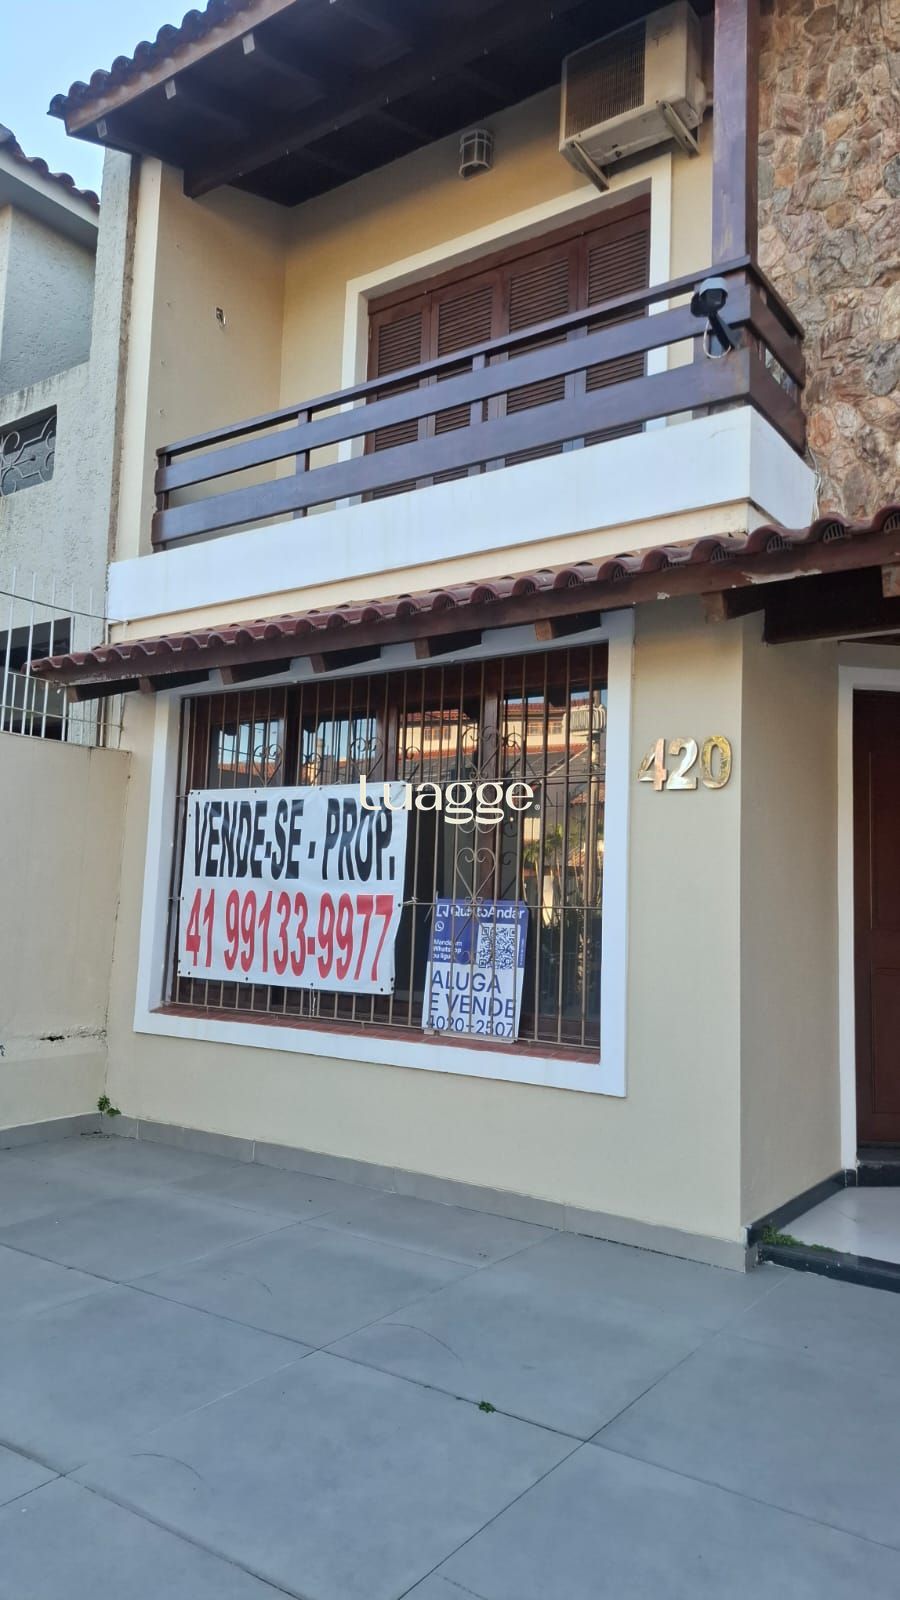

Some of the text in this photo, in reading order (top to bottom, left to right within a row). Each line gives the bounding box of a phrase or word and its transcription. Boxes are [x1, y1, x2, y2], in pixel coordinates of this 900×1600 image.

[638, 736, 731, 791] 420
[194, 799, 304, 881] VENDE-SE
[322, 796, 395, 881] PROP.
[450, 904, 525, 919] QuitoAndar
[185, 888, 394, 982] 41 99133-9977
[432, 970, 501, 993] ALUGA
[431, 992, 514, 1018] E VENDE
[427, 1015, 514, 1037] 4020-2507
